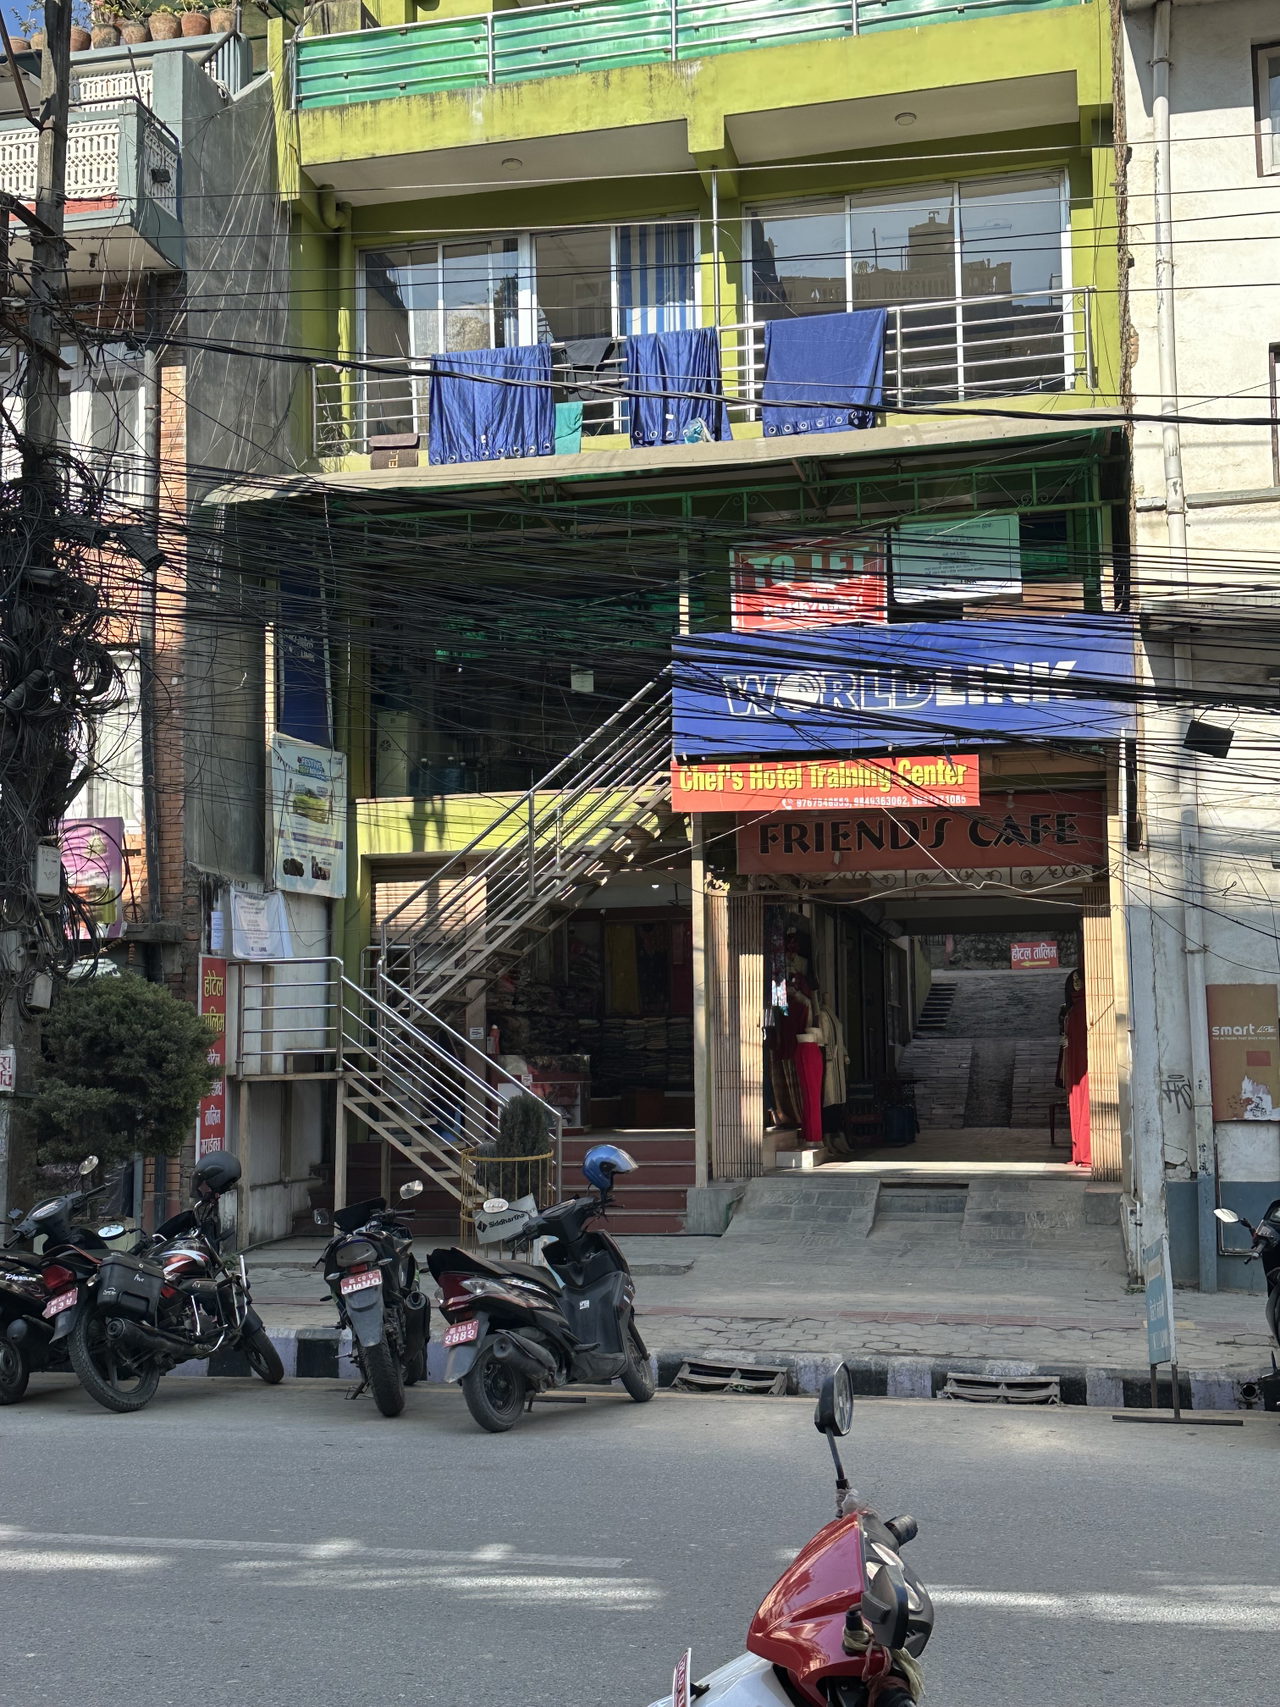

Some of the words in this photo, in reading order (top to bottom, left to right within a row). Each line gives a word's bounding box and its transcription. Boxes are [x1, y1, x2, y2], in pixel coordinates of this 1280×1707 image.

[679, 764, 744, 792] Chef's
[750, 762, 803, 790] Hotel
[807, 761, 892, 793] Training
[897, 758, 968, 787] Center
[759, 817, 953, 854] FRIEND'S
[969, 813, 1080, 848] CAFE
[204, 970, 224, 997] होटेल
[1212, 1023, 1255, 1036] smart
[488, 1213, 525, 1228] Siddhartha
